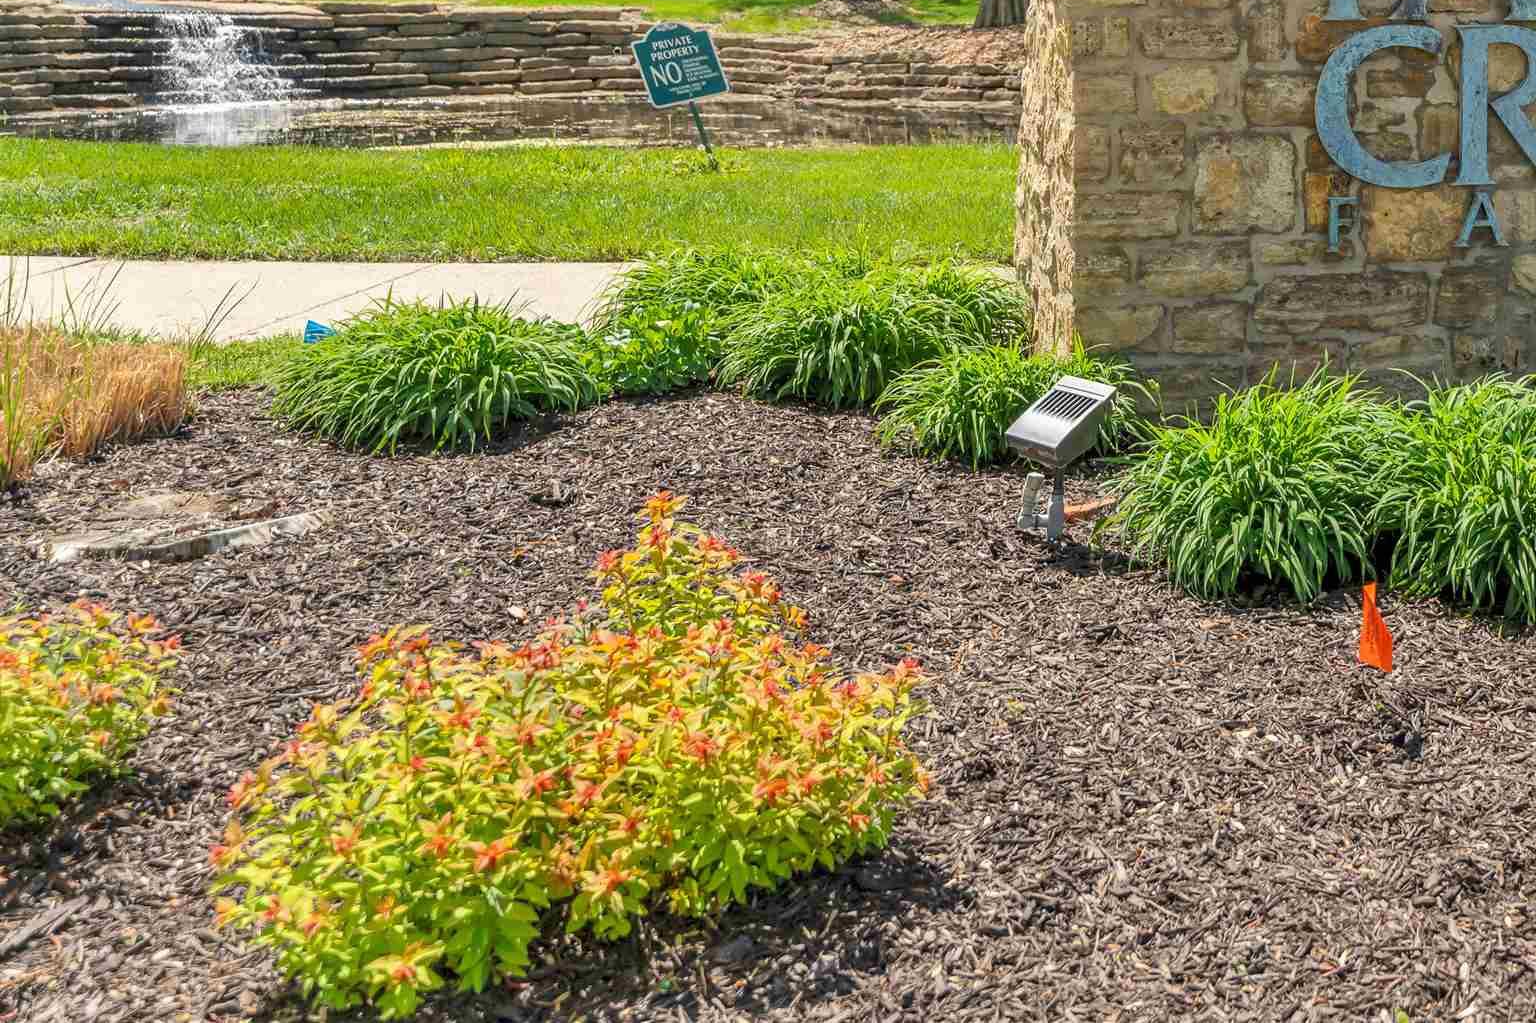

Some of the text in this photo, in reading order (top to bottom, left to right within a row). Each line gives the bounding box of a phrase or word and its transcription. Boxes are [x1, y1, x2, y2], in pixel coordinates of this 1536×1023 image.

[651, 35, 693, 51] PRIVATE
[650, 44, 699, 62] PROPERTY
[649, 61, 682, 87] NO
